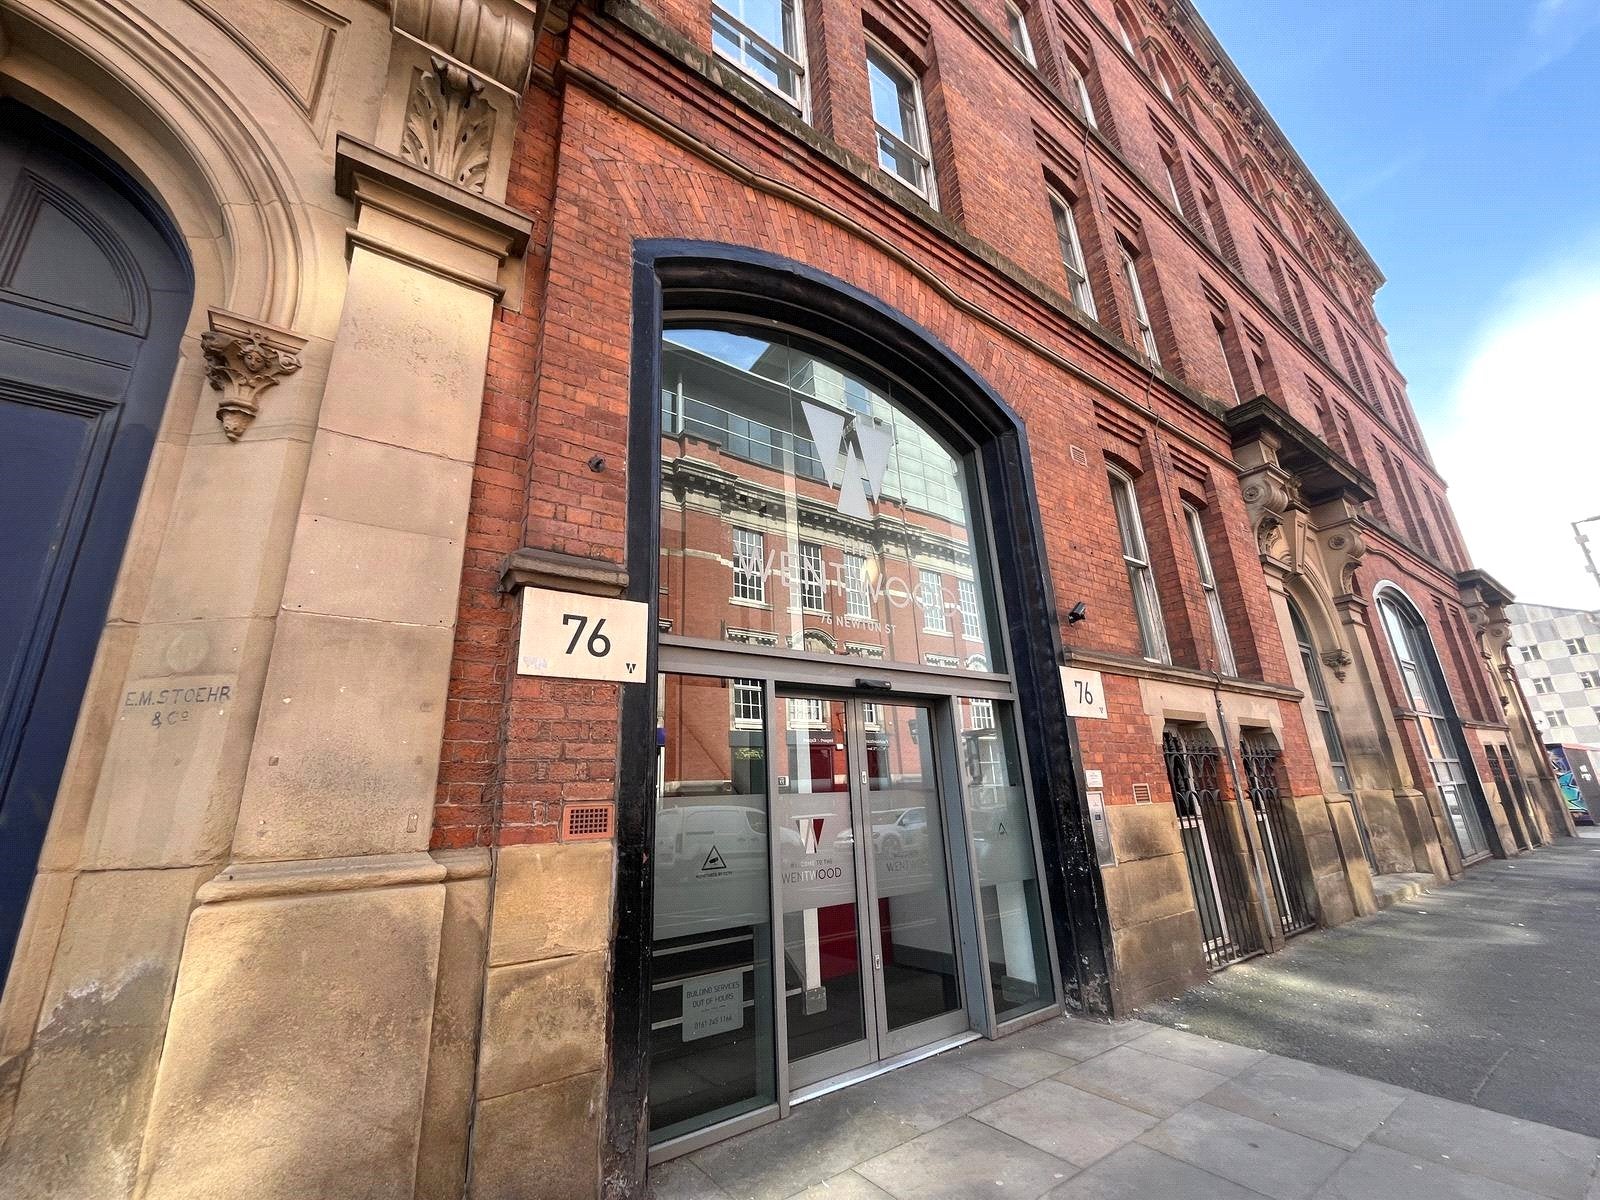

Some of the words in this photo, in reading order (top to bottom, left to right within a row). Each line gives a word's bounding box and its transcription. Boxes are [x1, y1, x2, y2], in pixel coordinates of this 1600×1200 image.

[733, 540, 957, 617] WENTWOOD
[821, 615, 833, 625] 76
[836, 615, 882, 633] NEWTON
[884, 623, 897, 634] ST
[562, 613, 611, 658] 76
[1074, 680, 1093, 705] 76
[152, 711, 162, 728] &
[781, 867, 842, 884] WENTWOOD
[686, 986, 713, 999] BUILDING
[714, 981, 740, 993] SERVICES
[692, 999, 704, 1008] OUT
[706, 997, 713, 1005] OF
[715, 993, 734, 1002] HOURS
